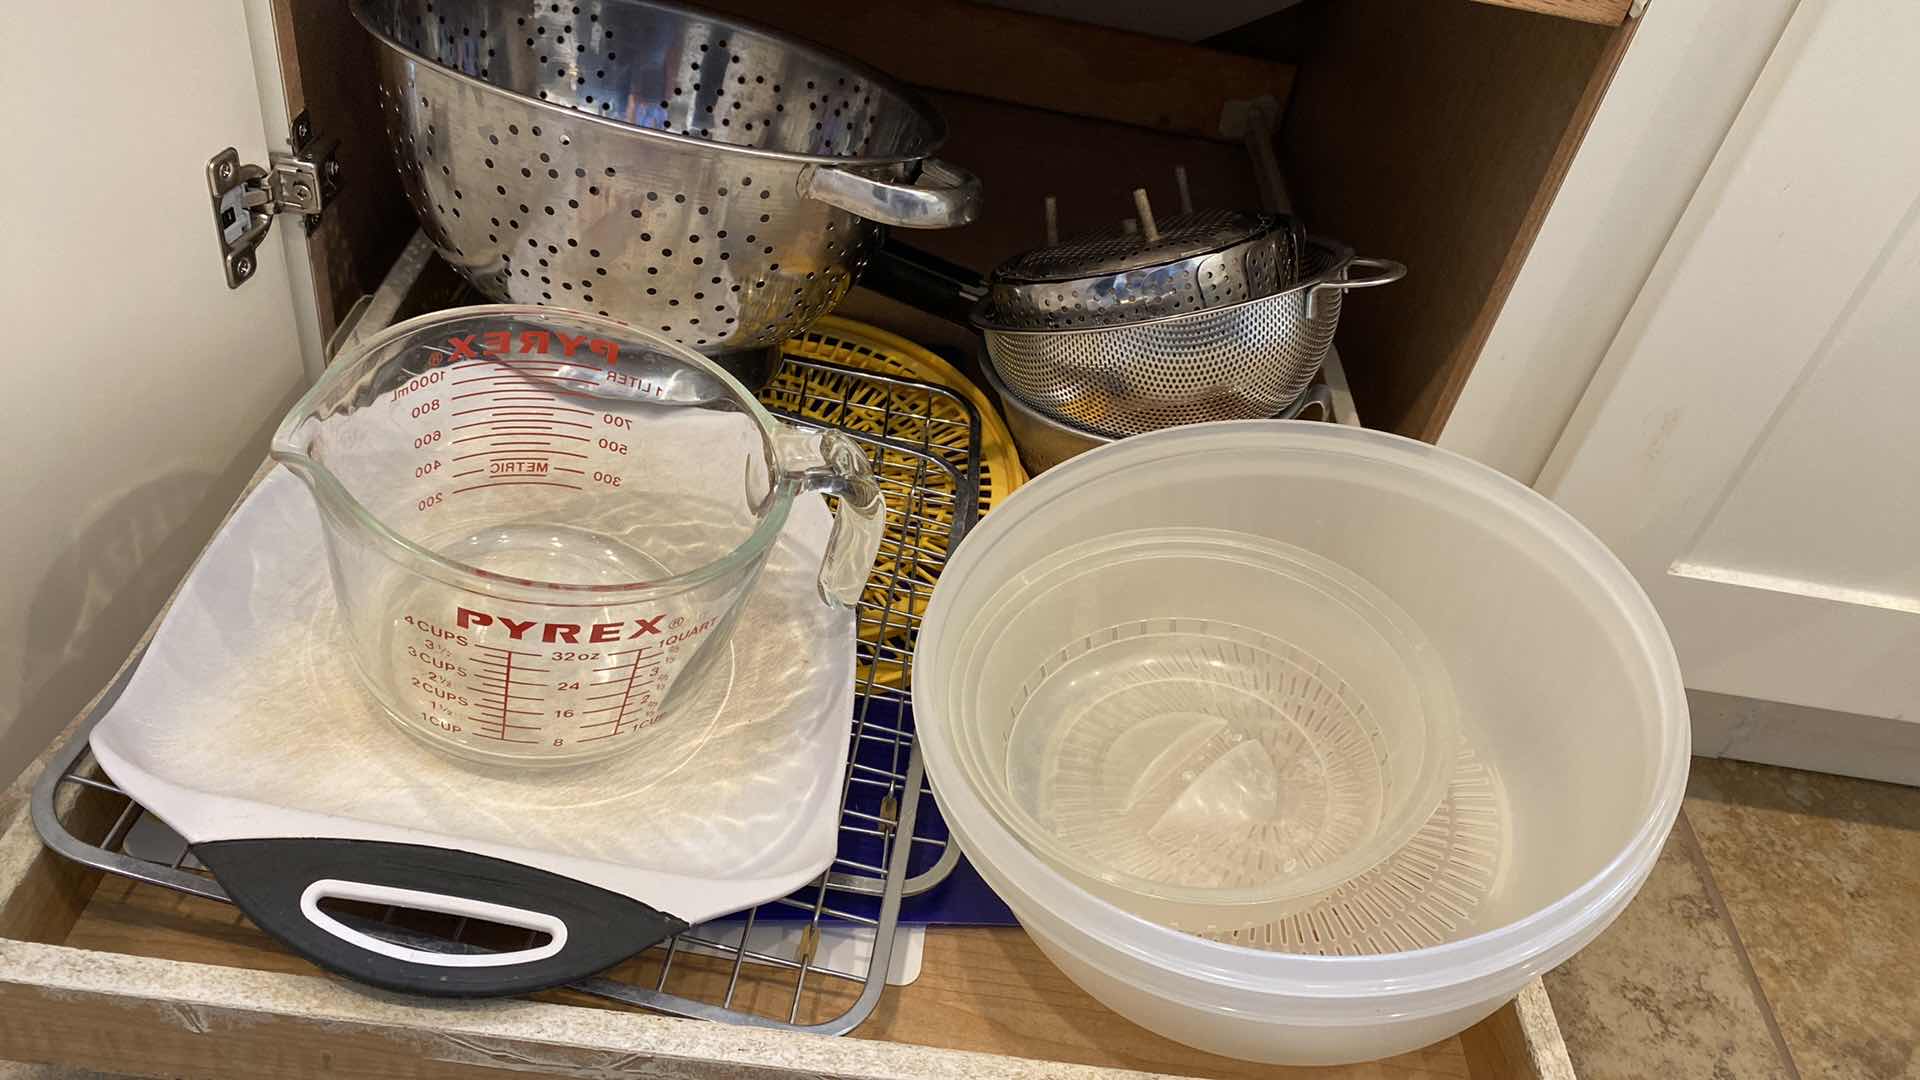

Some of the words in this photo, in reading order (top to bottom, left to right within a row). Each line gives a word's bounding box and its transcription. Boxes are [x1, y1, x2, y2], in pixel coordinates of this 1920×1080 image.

[557, 682, 580, 691] 24
[555, 710, 574, 718] 16
[553, 738, 564, 747] 8
